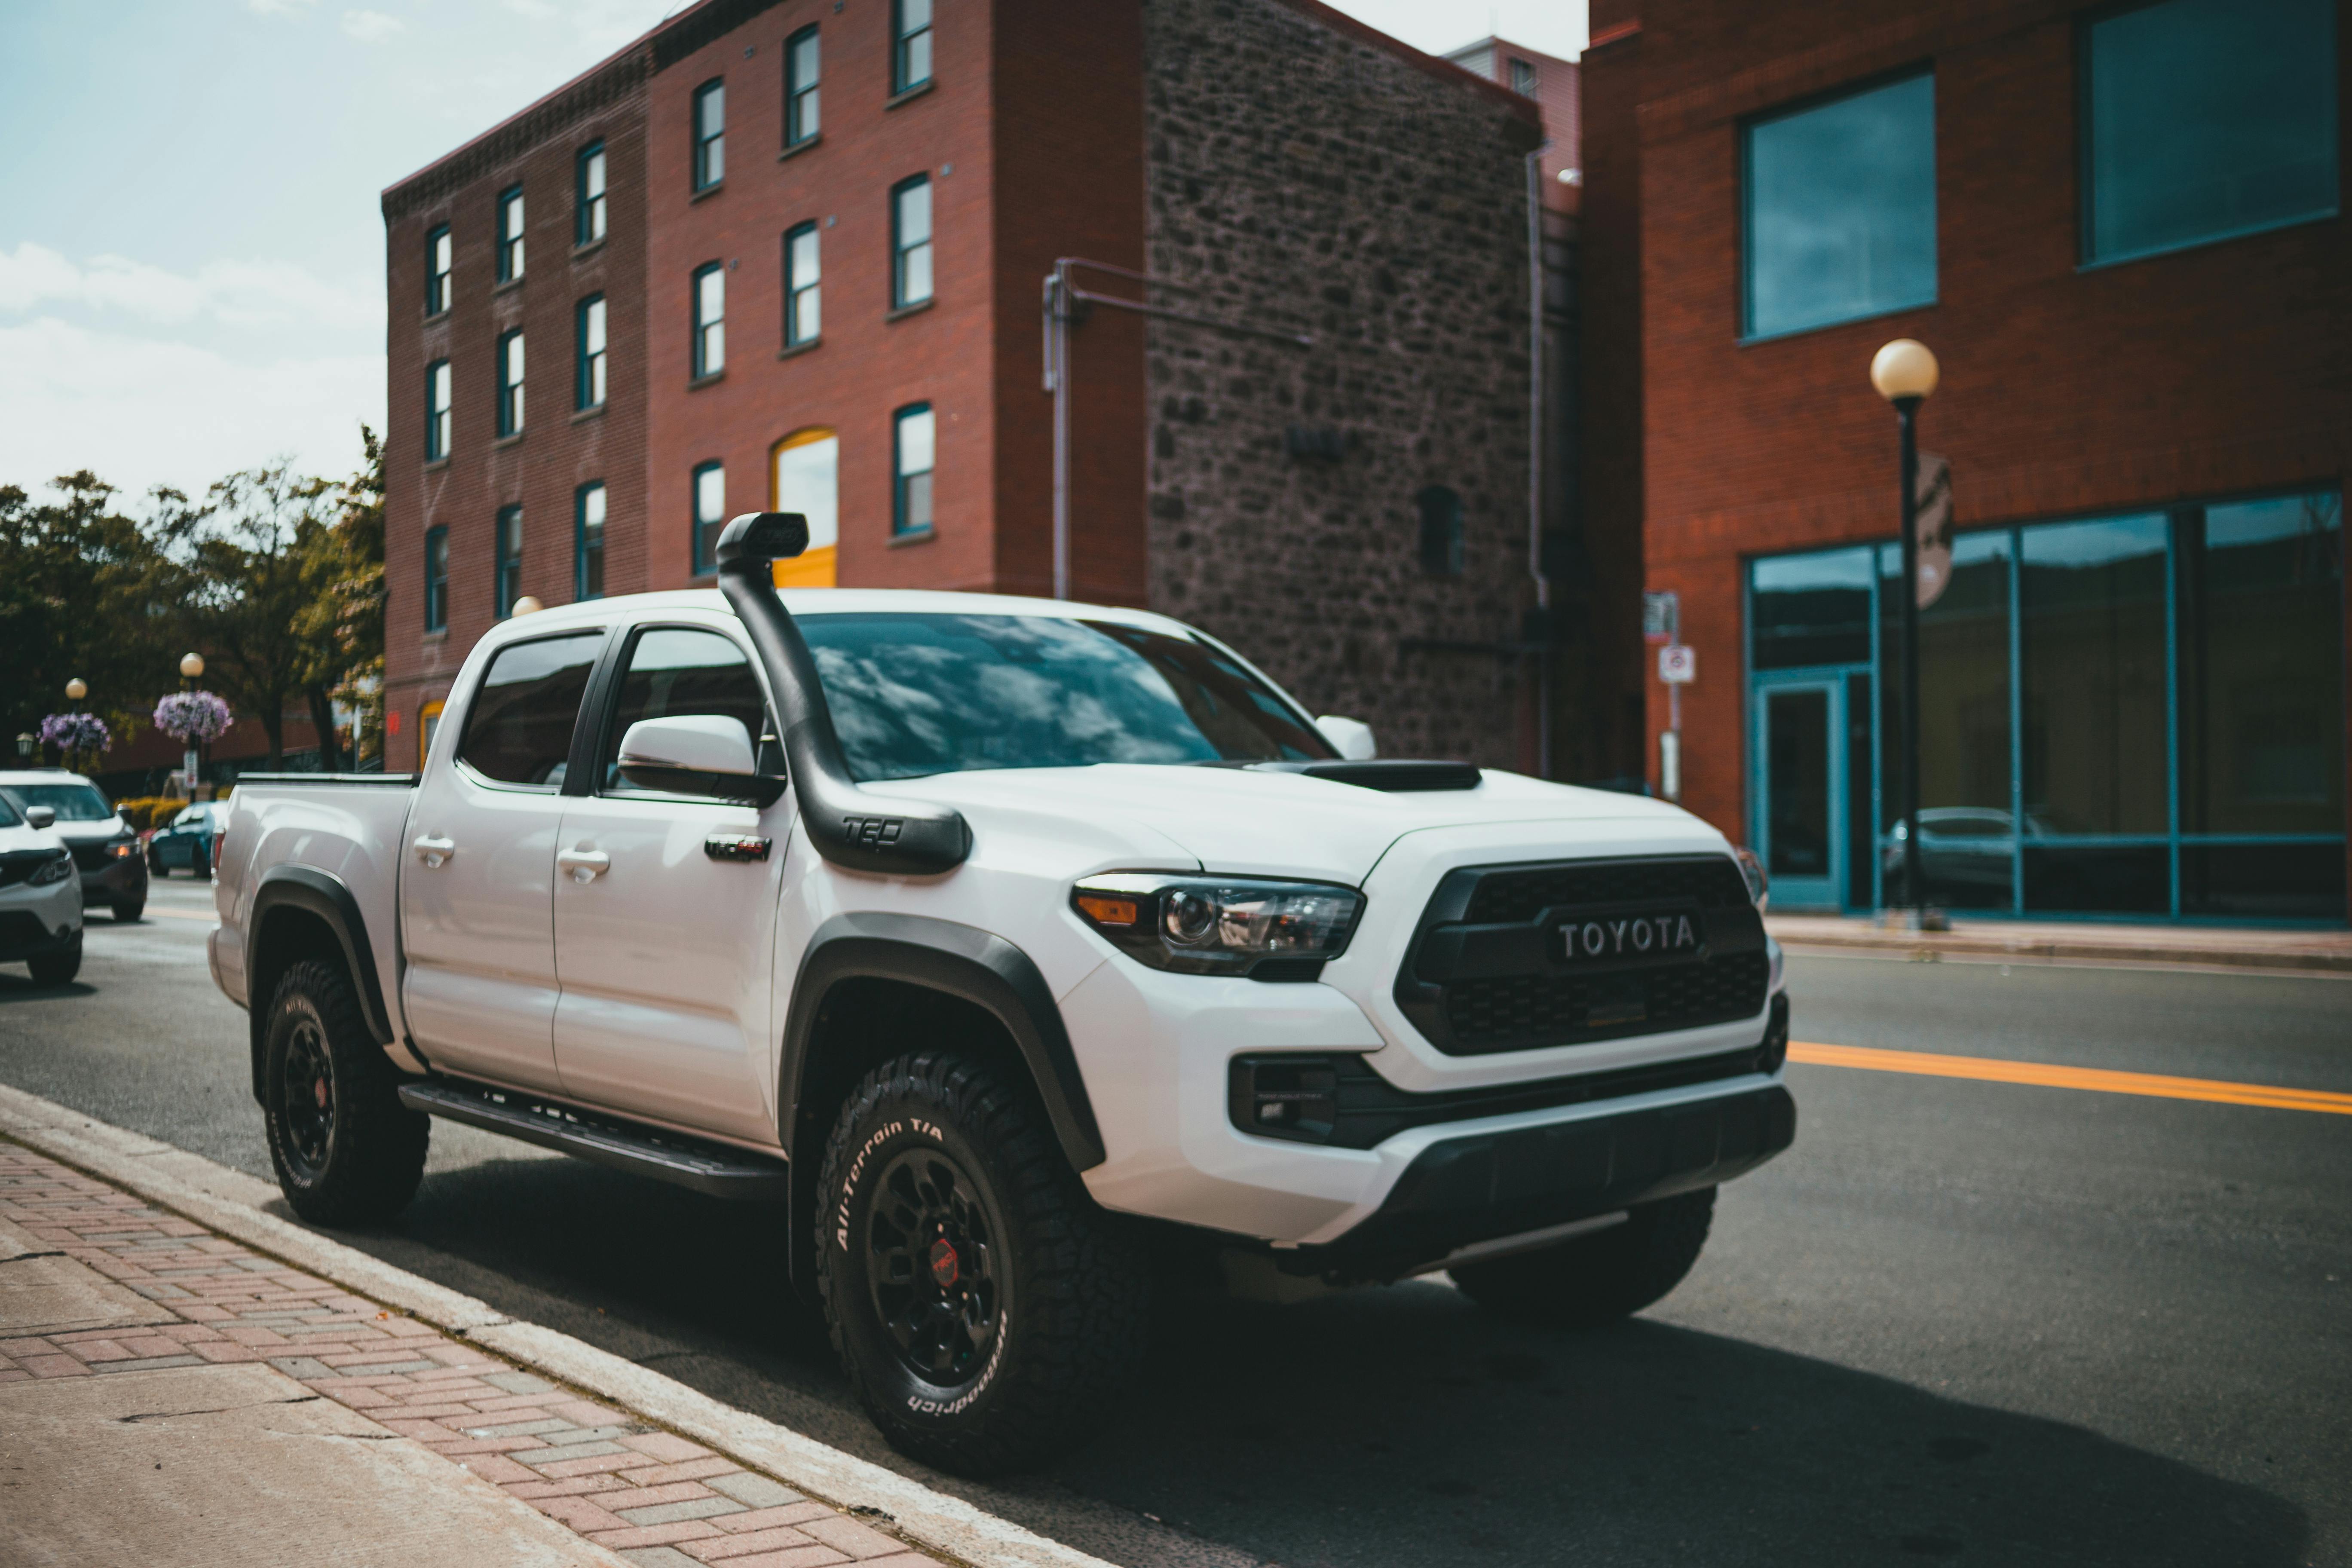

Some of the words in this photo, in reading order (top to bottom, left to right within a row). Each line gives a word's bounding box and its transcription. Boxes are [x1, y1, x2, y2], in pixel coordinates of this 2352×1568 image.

[1559, 915, 1695, 958] TOYOTA
[837, 1121, 903, 1252] All-Terrain
[910, 1118, 943, 1142] T/A
